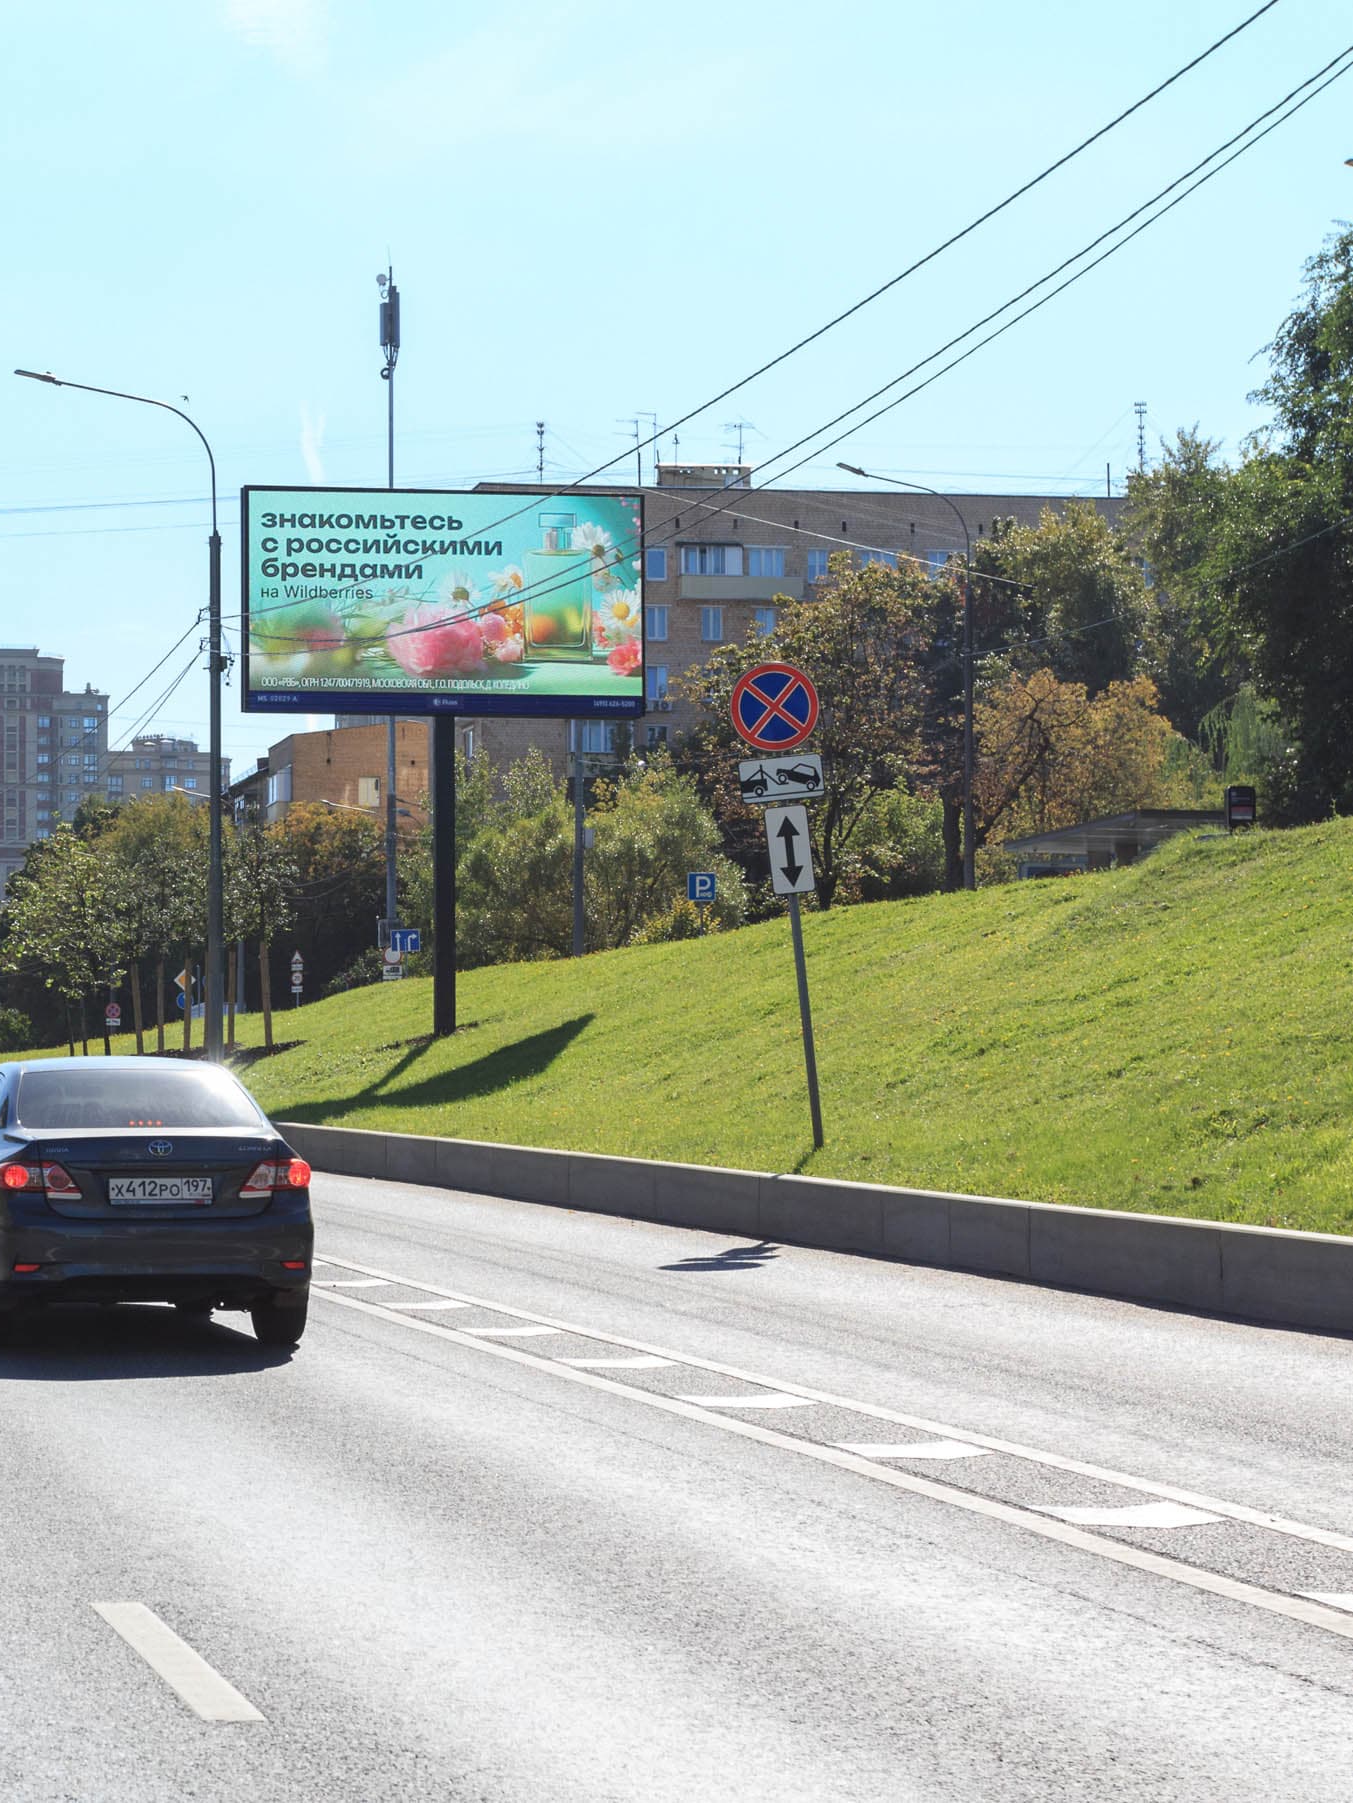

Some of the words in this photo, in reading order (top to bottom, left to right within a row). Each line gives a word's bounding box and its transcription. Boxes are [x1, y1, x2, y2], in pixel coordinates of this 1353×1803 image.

[261, 512, 463, 530] знакомьтесь
[261, 537, 279, 553] с
[286, 533, 502, 556] российскими
[261, 557, 423, 581] брендами
[261, 587, 279, 598] на
[284, 585, 373, 599] Wildberries
[696, 876, 711, 898] P
[184, 1179, 207, 1192] 197
